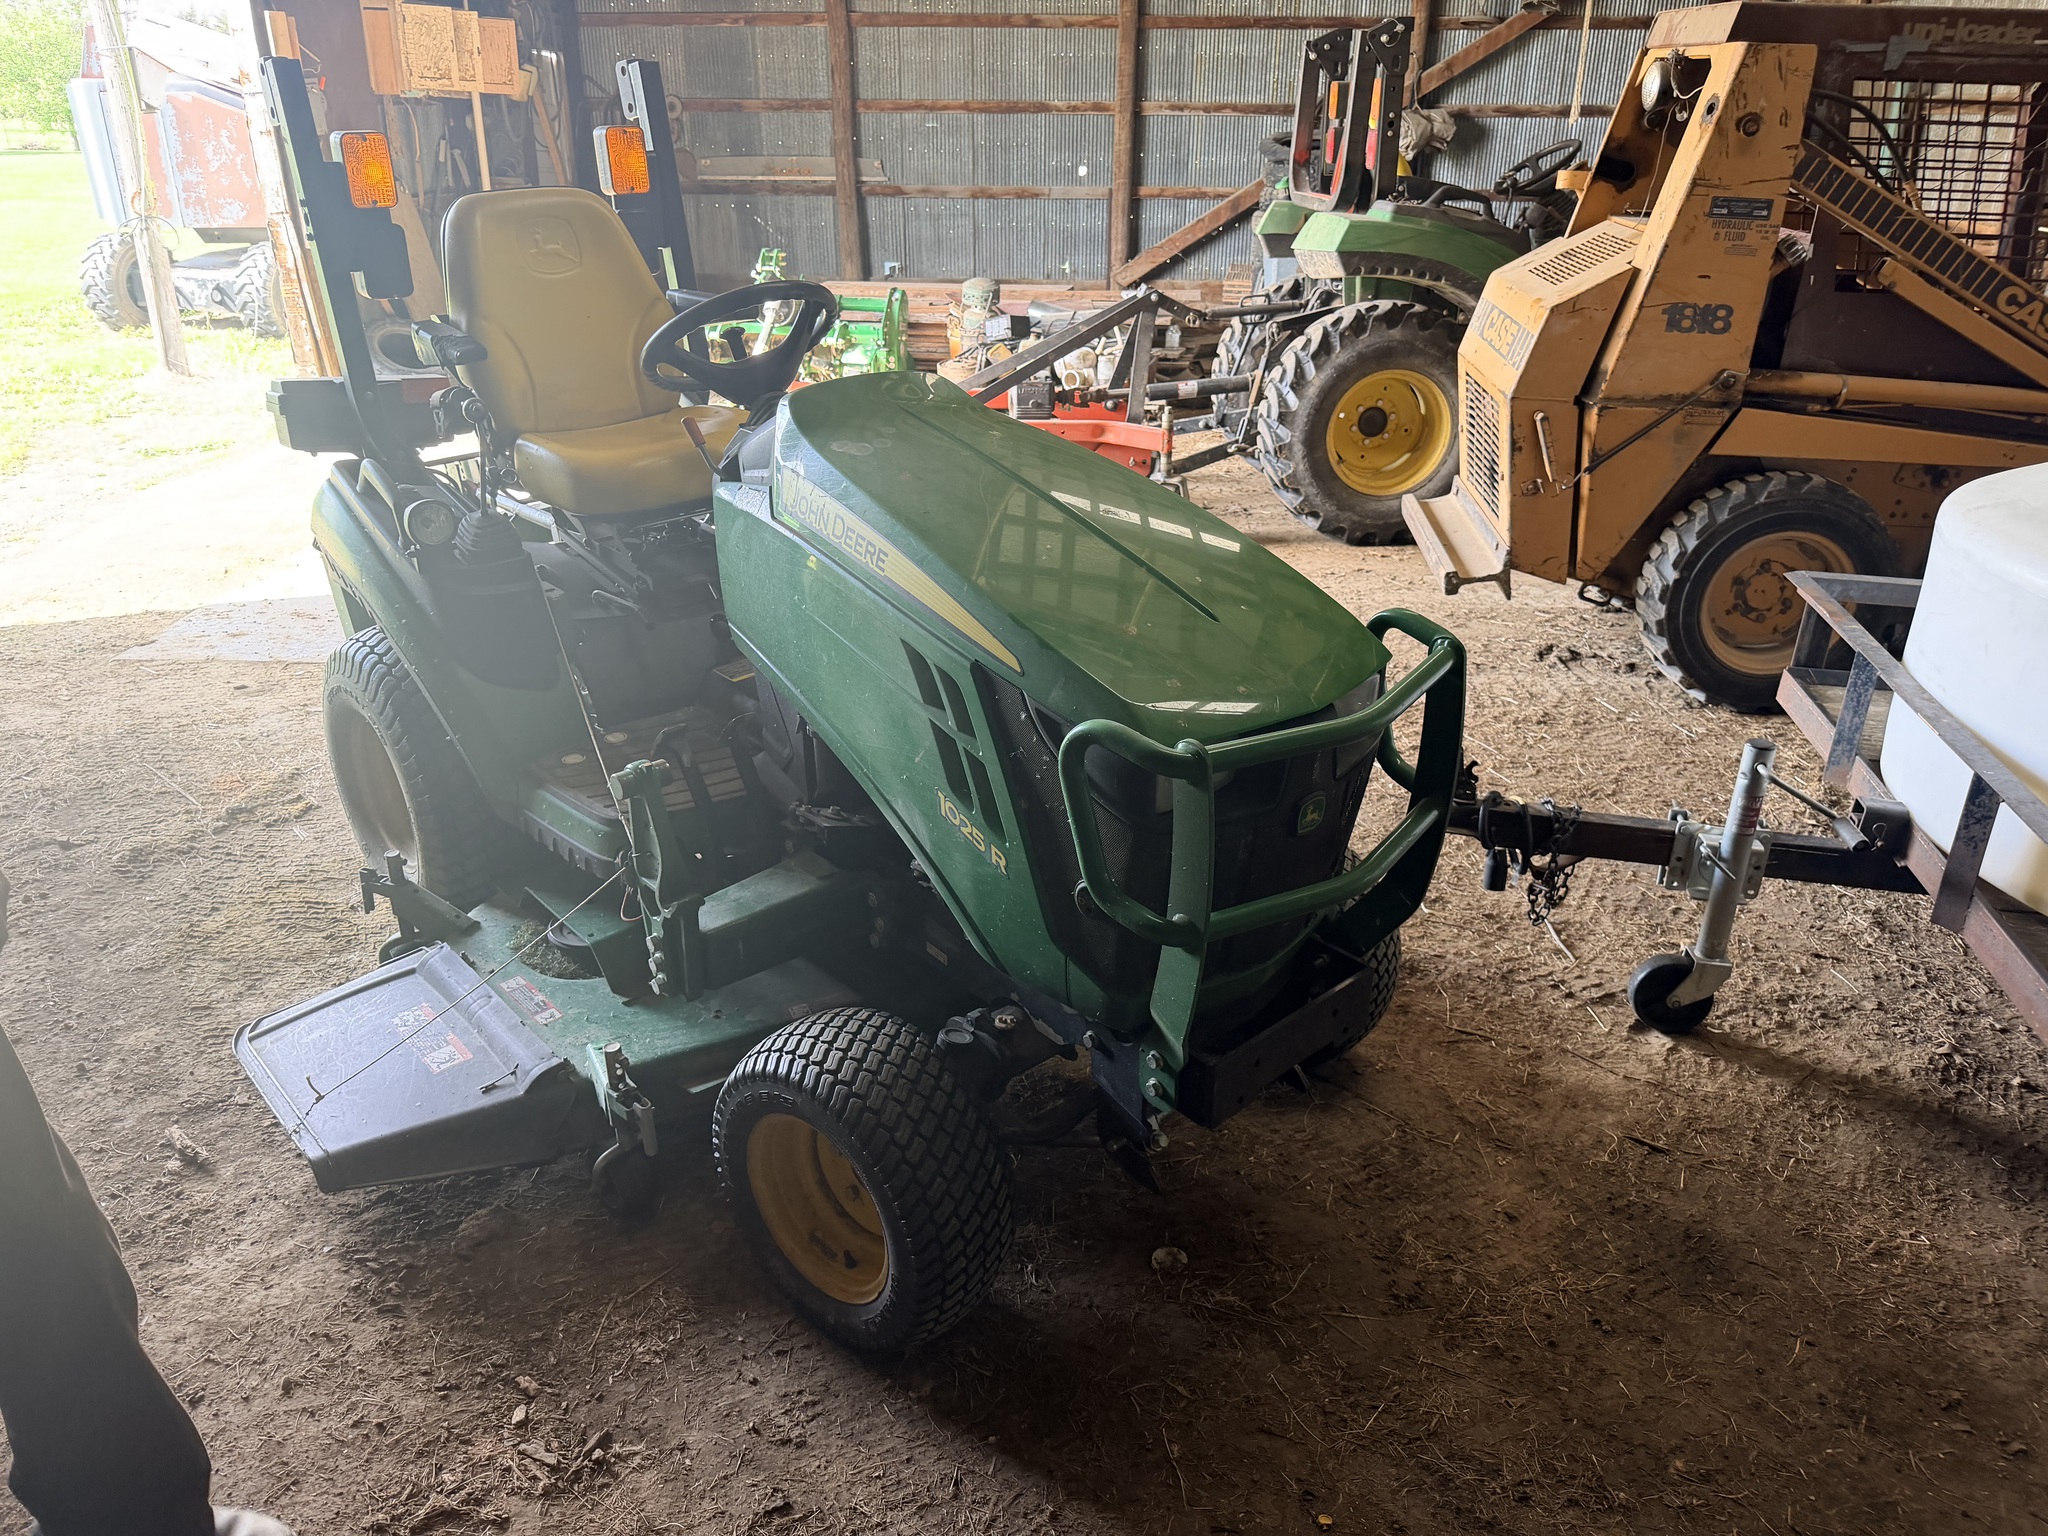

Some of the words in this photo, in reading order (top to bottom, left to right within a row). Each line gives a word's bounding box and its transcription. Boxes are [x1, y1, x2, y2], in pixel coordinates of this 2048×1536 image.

[1902, 17, 2041, 44] uni-loader
[1711, 219, 1755, 231] HYDRAULIC
[1723, 231, 1746, 242] FLUID
[1482, 307, 1520, 357] CASE
[790, 486, 830, 533] JOHN
[831, 513, 889, 574] DEERE
[937, 789, 986, 853] 1025
[990, 843, 1009, 876] R
